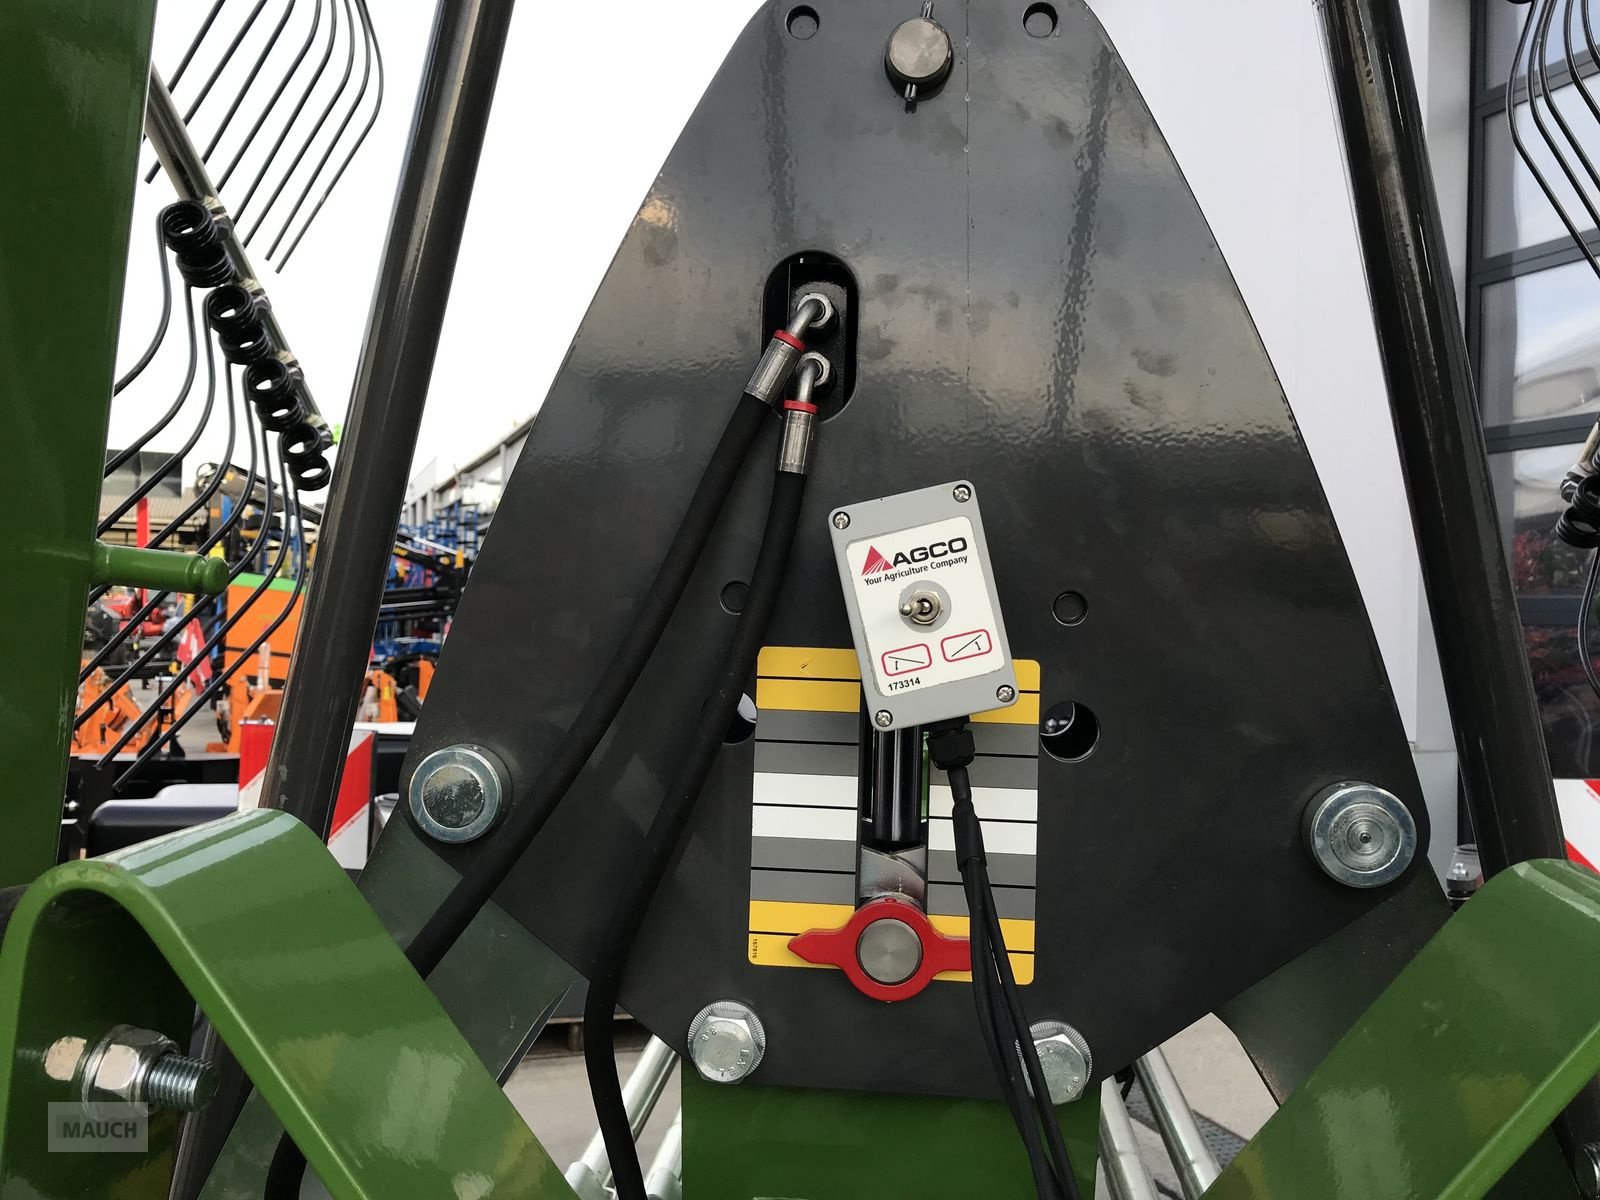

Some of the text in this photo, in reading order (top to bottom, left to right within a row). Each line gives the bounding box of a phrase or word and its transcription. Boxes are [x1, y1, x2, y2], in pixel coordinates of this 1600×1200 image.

[893, 537, 968, 567] AGCO
[864, 555, 968, 586] Your Agriculture Company
[888, 677, 921, 691] 173314
